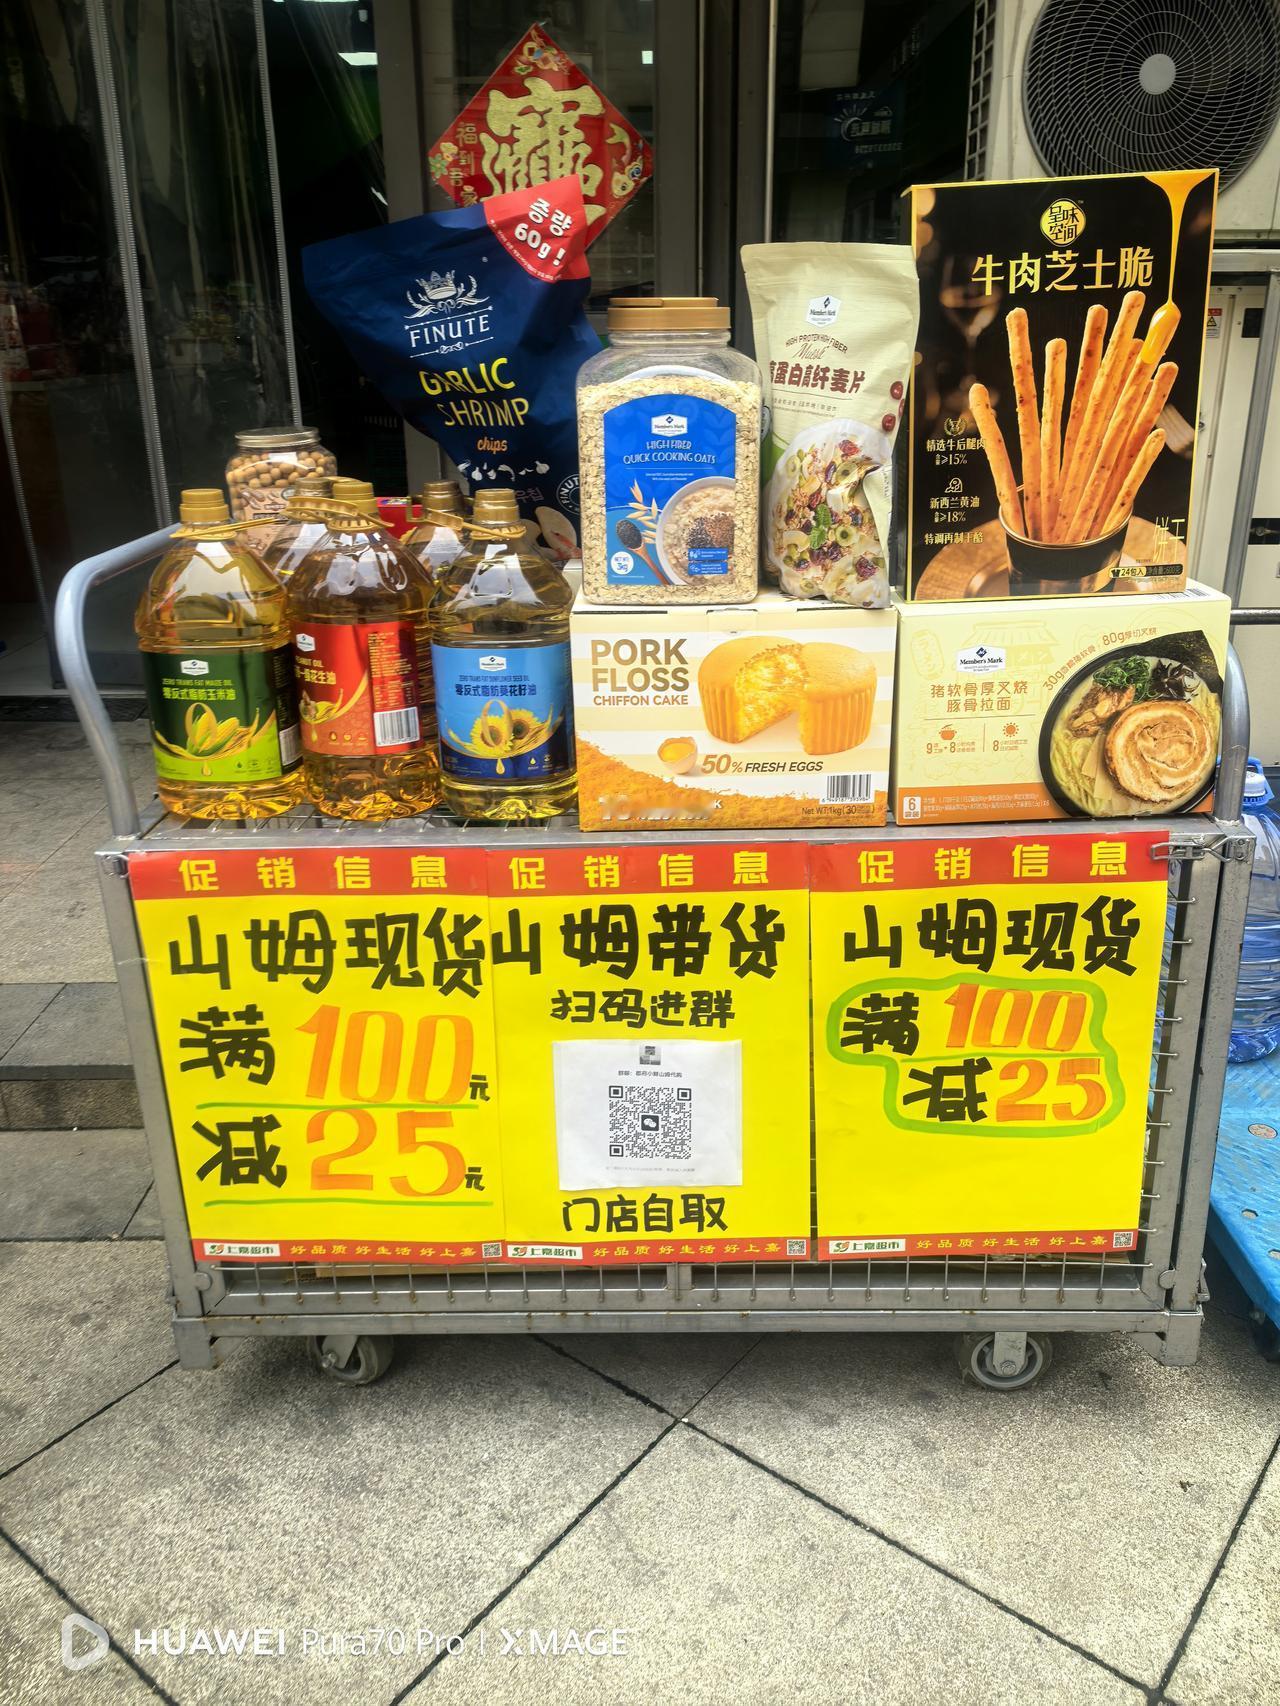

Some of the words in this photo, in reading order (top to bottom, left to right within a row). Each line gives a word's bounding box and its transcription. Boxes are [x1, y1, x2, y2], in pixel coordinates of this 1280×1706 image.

[528, 198, 572, 236] 증량
[971, 246, 1154, 296] 牛肉芝士脆
[410, 315, 490, 348] FINUTE
[829, 338, 848, 354] FIBER
[419, 358, 515, 395] GARLIC
[437, 397, 529, 427] SHRIMP
[477, 437, 508, 454] chips
[646, 440, 670, 450] HIGH
[623, 453, 650, 464] QUICK
[652, 452, 693, 462] COOKING
[694, 454, 716, 464] OATS
[560, 477, 580, 504] FINUT
[930, 496, 980, 509] 新西兰黄油
[591, 639, 689, 666] PORK
[591, 667, 690, 692] FLOSS
[930, 680, 1028, 698] 猪软骨厚叉烧
[593, 695, 650, 706] CHIFFON
[654, 695, 688, 706] CAKE
[947, 696, 1012, 713] 豚骨拉面
[702, 754, 743, 774] 50%
[744, 762, 785, 773] FRESH
[789, 761, 823, 772] EGGS
[801, 807, 815, 815] Net
[908, 797, 916, 811] 6
[509, 851, 769, 890] 促销信息
[857, 841, 1128, 884] 促销信息
[179, 855, 448, 892] 促销信息
[491, 902, 785, 980] 山姆带货
[843, 895, 1141, 977] 山姆现货
[169, 907, 485, 999] 山姆现货
[550, 988, 735, 1029] 扫码进群
[563, 1193, 729, 1233] 门店自取
[227, 1245, 274, 1255] 上嘉超市
[290, 1244, 348, 1256] 好品质
[355, 1245, 412, 1256] 好生活
[419, 1247, 476, 1257] 好上嘉
[530, 1247, 577, 1257] 上嘉超市
[593, 1245, 650, 1257] 好品质
[658, 1244, 716, 1256] 好生活
[724, 1242, 782, 1254] 好上嘉
[853, 1240, 901, 1251] 上嘉超市
[916, 1237, 973, 1249] 好品质
[982, 1236, 1040, 1248] 好生活
[1049, 1235, 1107, 1246] 好上嘉
